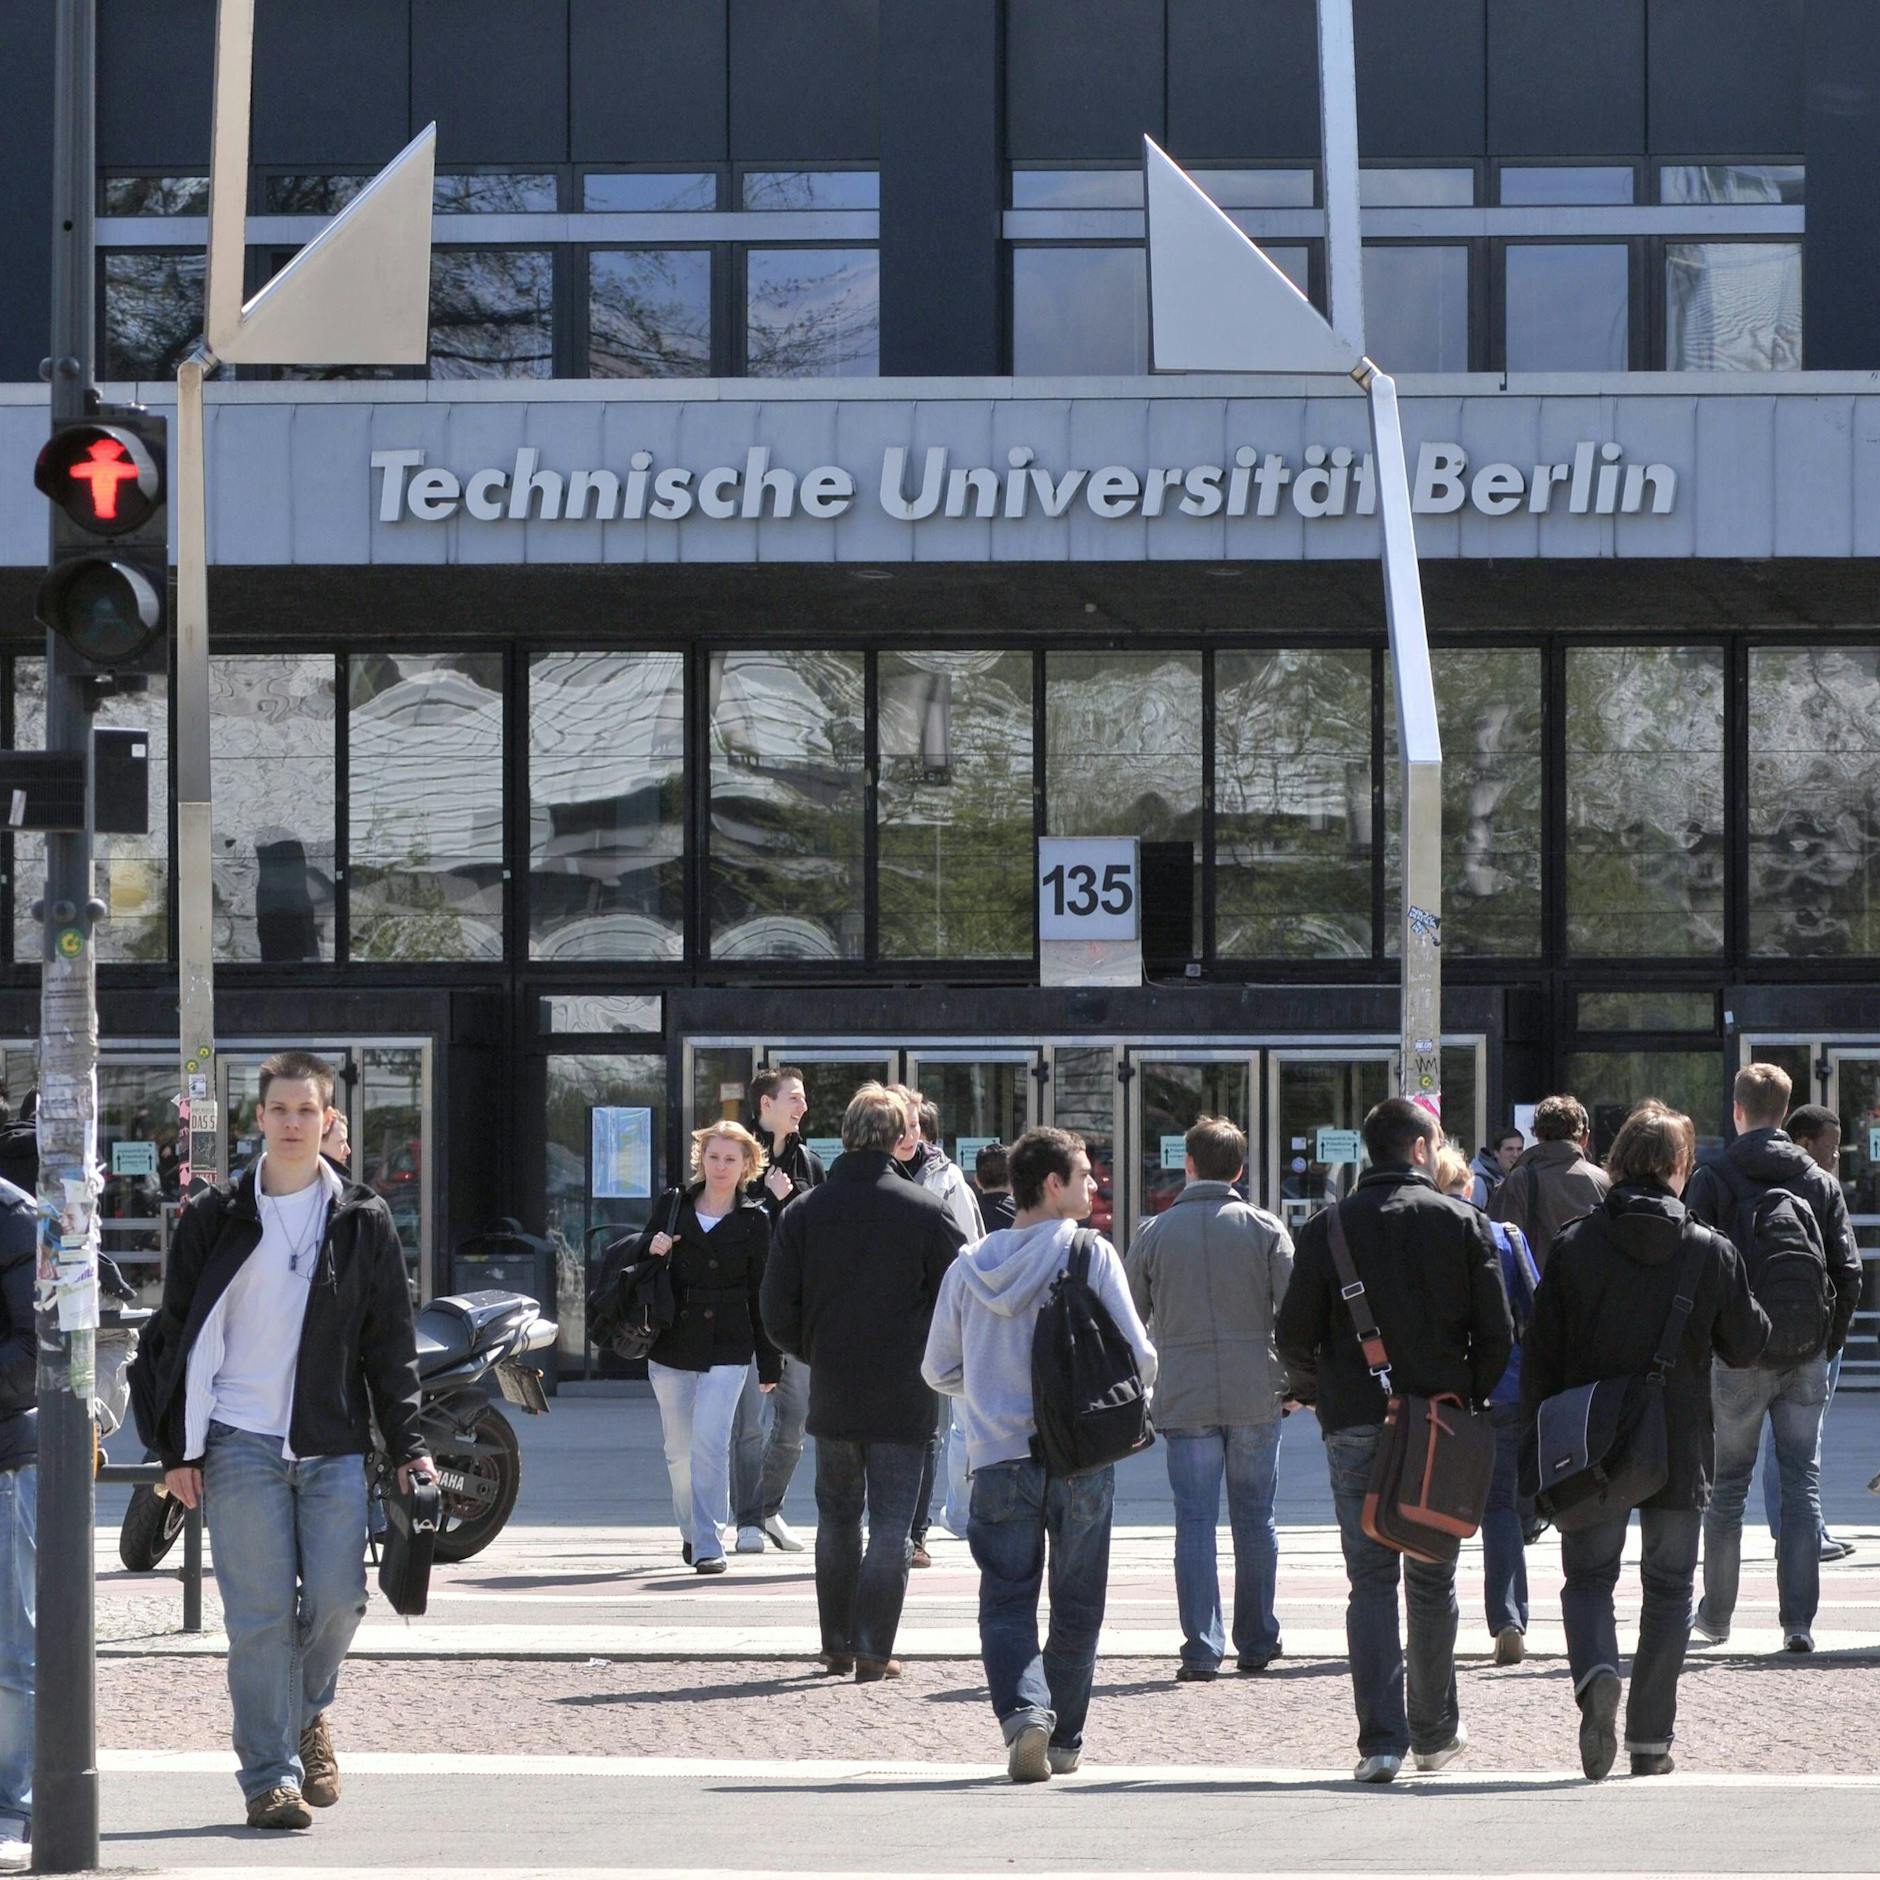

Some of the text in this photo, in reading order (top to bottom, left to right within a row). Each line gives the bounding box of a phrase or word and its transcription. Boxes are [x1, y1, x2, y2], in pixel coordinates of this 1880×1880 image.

[370, 440, 1677, 523] Technische Universität Berlin
[1042, 864, 1133, 916] 135
